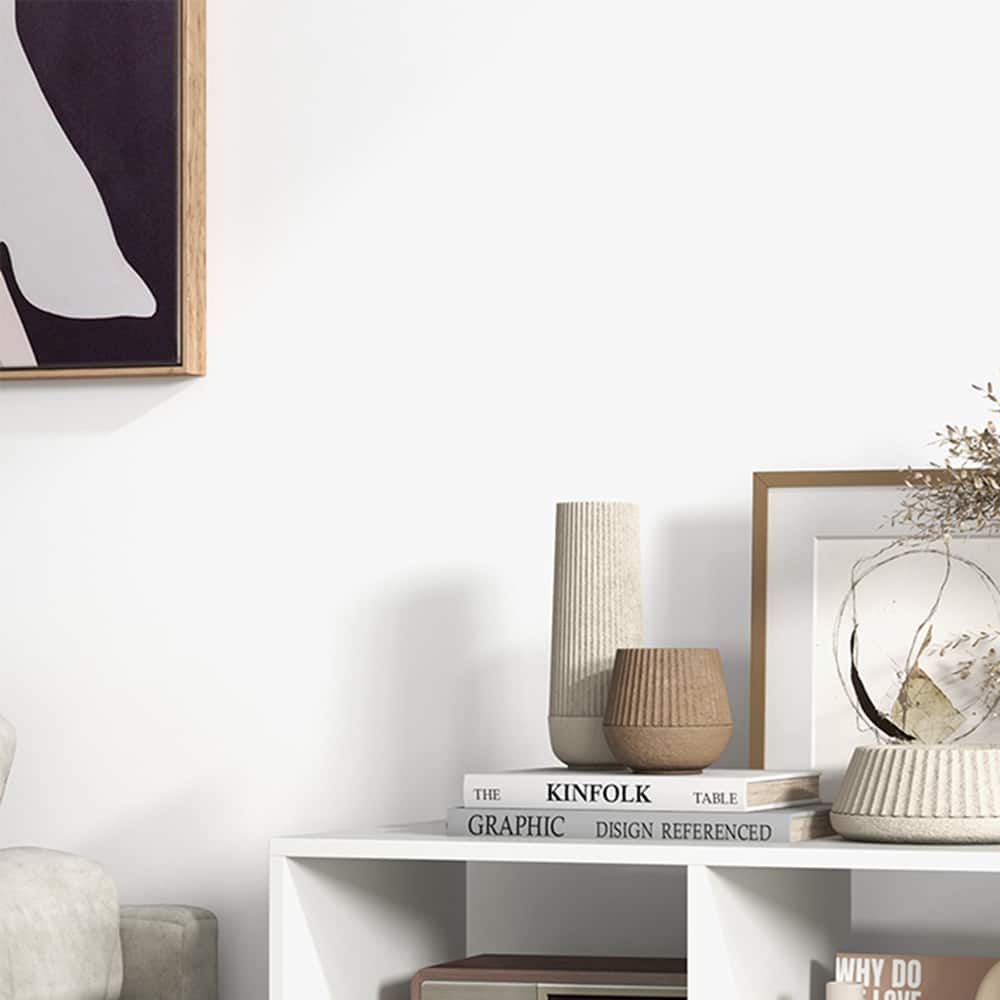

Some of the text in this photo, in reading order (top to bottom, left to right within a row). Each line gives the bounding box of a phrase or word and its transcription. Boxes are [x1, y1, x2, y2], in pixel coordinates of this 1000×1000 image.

[473, 782, 738, 806] THE KINFOLK TABLE
[467, 814, 772, 842] GRAPHIC DISIGN REFERENCED
[835, 956, 922, 989] WHY DO
